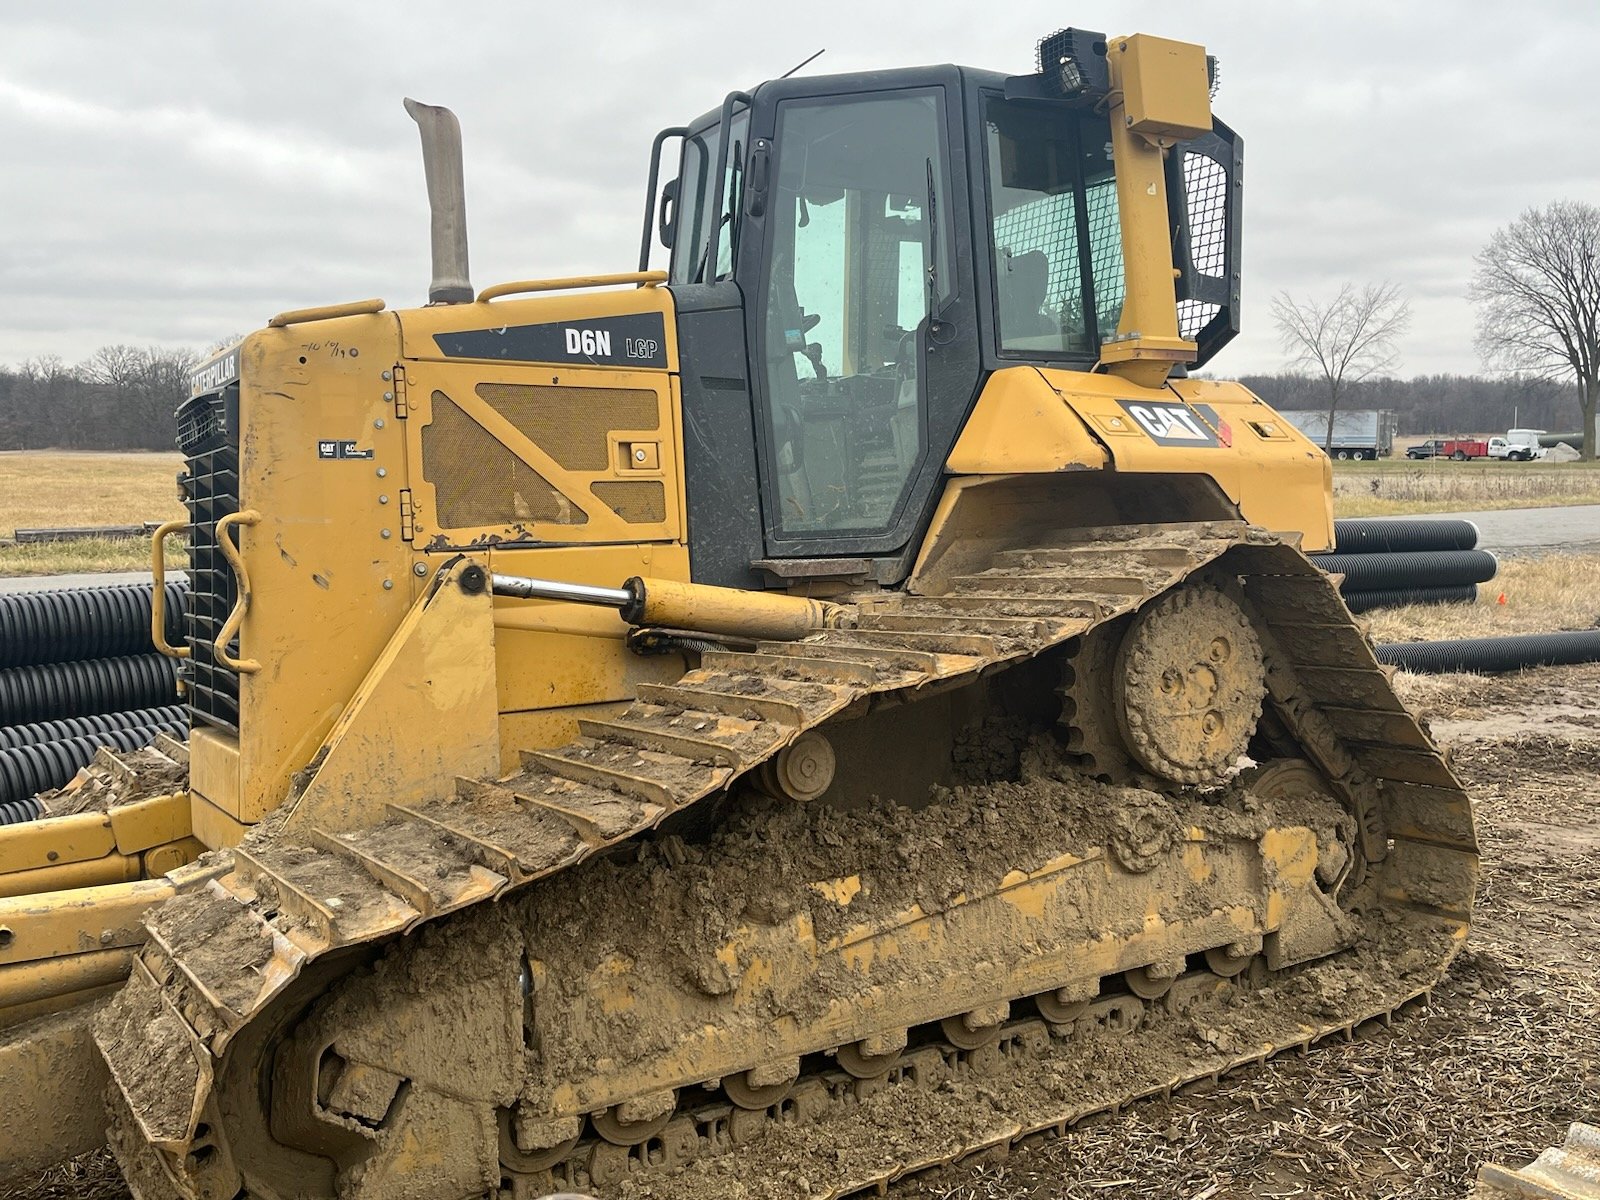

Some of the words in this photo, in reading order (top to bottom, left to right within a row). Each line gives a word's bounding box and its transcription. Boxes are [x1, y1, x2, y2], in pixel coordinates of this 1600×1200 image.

[565, 328, 612, 357] D6N
[626, 338, 658, 359] LGP
[191, 354, 235, 397] CATERPILLAR
[1128, 405, 1210, 441] CAT
[320, 443, 336, 453] CAT
